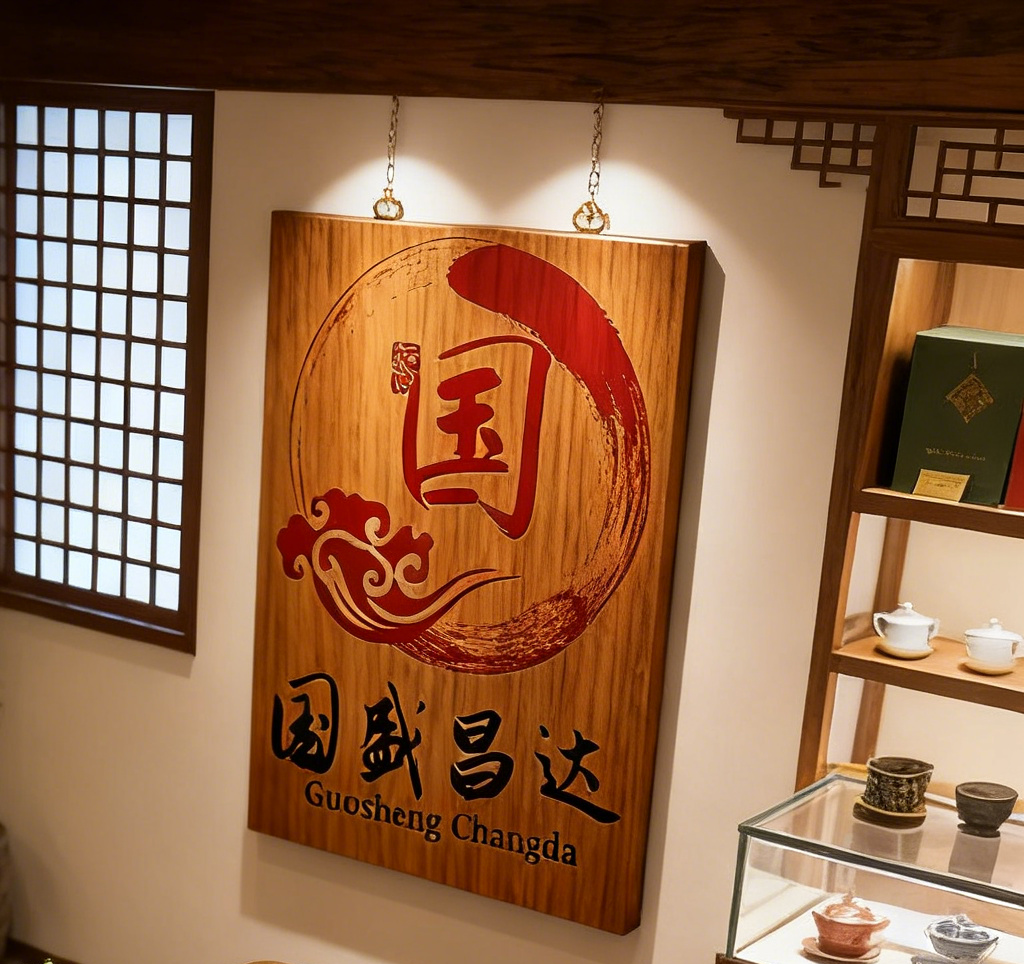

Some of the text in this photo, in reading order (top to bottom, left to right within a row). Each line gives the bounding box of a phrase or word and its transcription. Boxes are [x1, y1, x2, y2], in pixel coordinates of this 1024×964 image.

[396, 335, 551, 539] 国
[271, 672, 621, 824] 国盛昌达
[304, 780, 577, 867] Guosheng Changda
